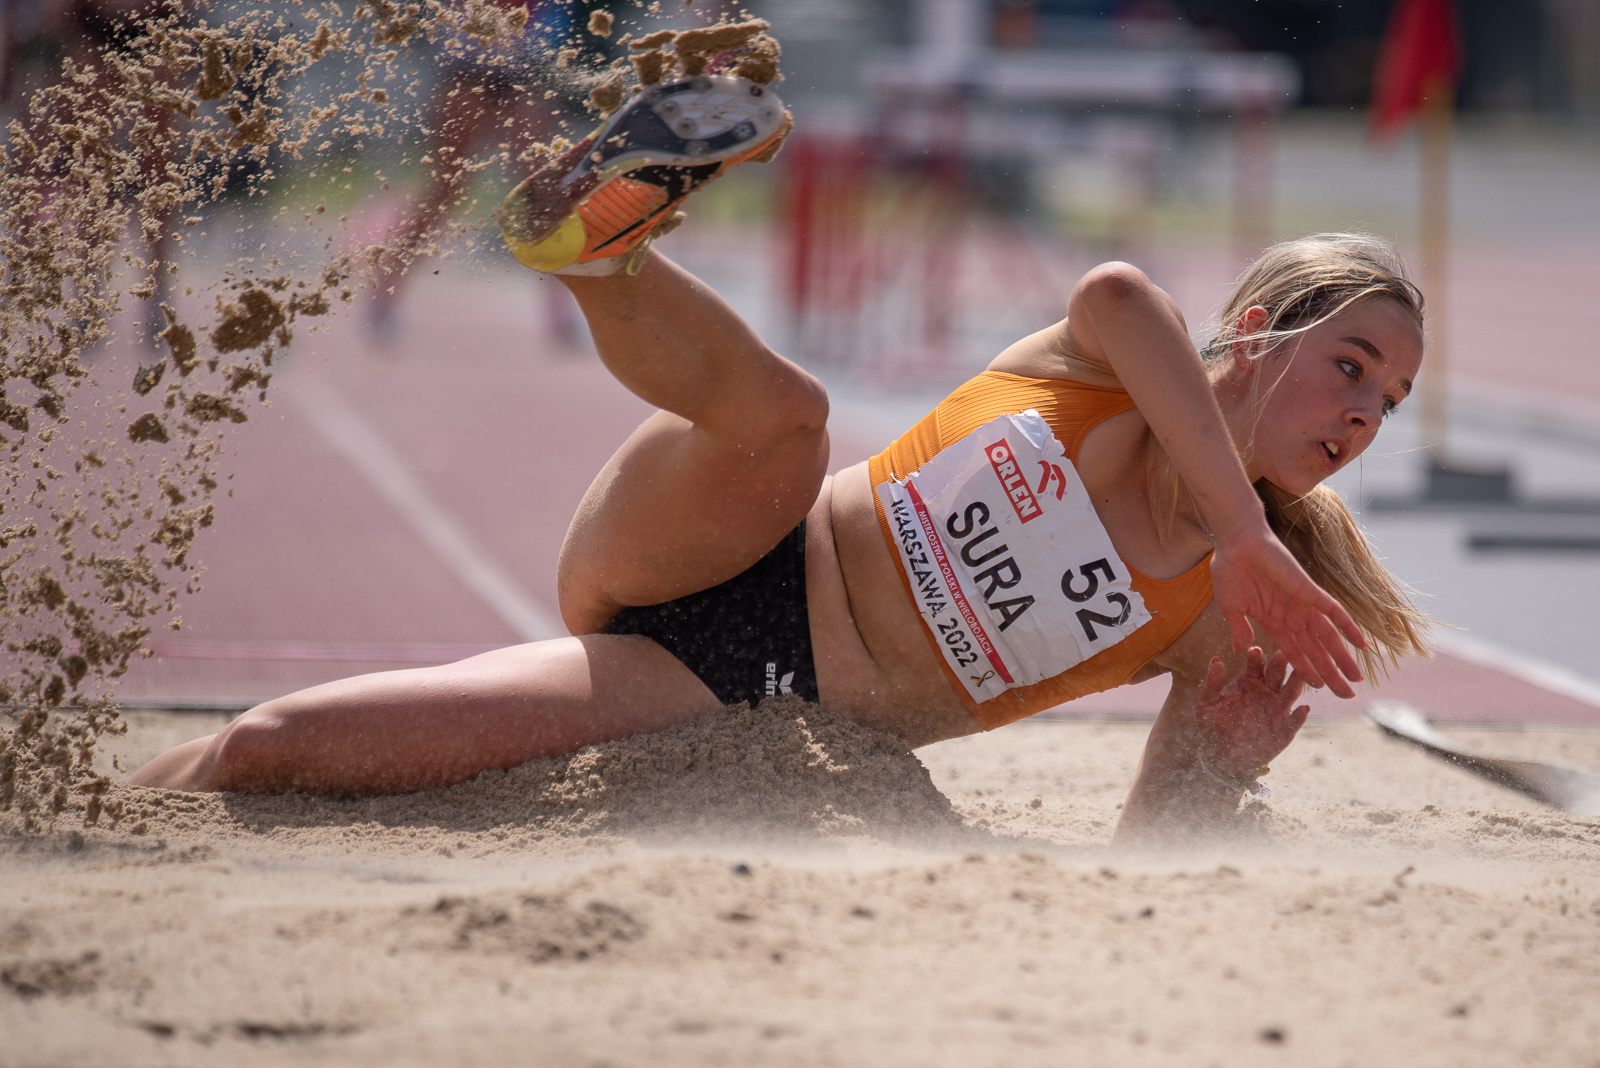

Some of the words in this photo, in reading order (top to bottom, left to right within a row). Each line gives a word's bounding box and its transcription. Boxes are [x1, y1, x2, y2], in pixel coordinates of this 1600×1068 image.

[991, 446, 1037, 518] ORLEN
[890, 499, 948, 618] WARSZAWA
[937, 617, 978, 668] 2022
[918, 510, 944, 562] MISTRZOSTWA
[940, 562, 958, 590] POLSKI
[957, 599, 992, 655] WIELOBOJACH
[946, 501, 1036, 632] SURA
[1060, 558, 1132, 642] 52
